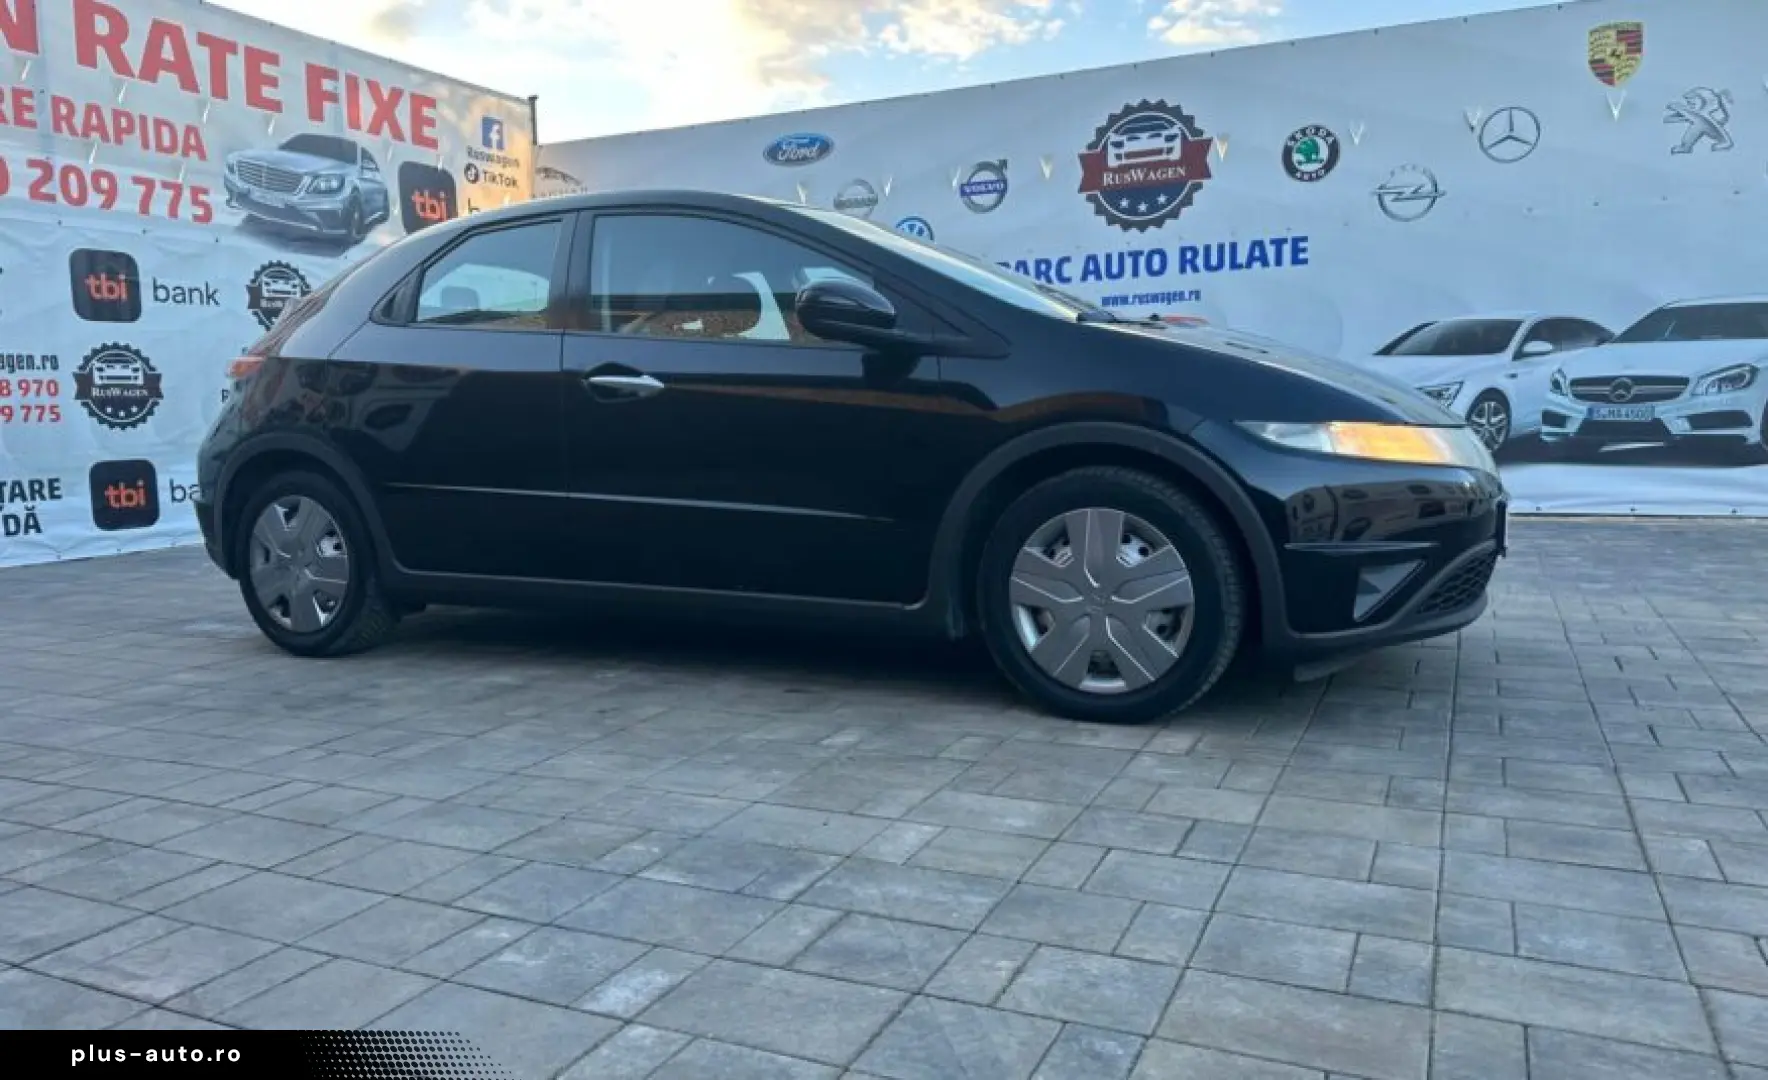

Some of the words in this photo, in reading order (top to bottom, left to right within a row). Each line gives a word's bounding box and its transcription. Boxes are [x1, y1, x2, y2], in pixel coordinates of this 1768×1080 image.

[73, 0, 283, 114] RATE
[305, 62, 438, 150] FIXE
[51, 94, 207, 161] RAPIDA
[27, 158, 118, 210] 209
[131, 175, 213, 224] 775
[994, 254, 1072, 284] ARC
[1080, 247, 1168, 284] AUTO
[1178, 235, 1309, 275] RULATE
[84, 272, 128, 301] tbi
[152, 277, 220, 306] bank
[17, 379, 59, 397] 970
[20, 405, 61, 423] 775
[104, 480, 146, 508] tbi
[2, 504, 43, 536] DĂ
